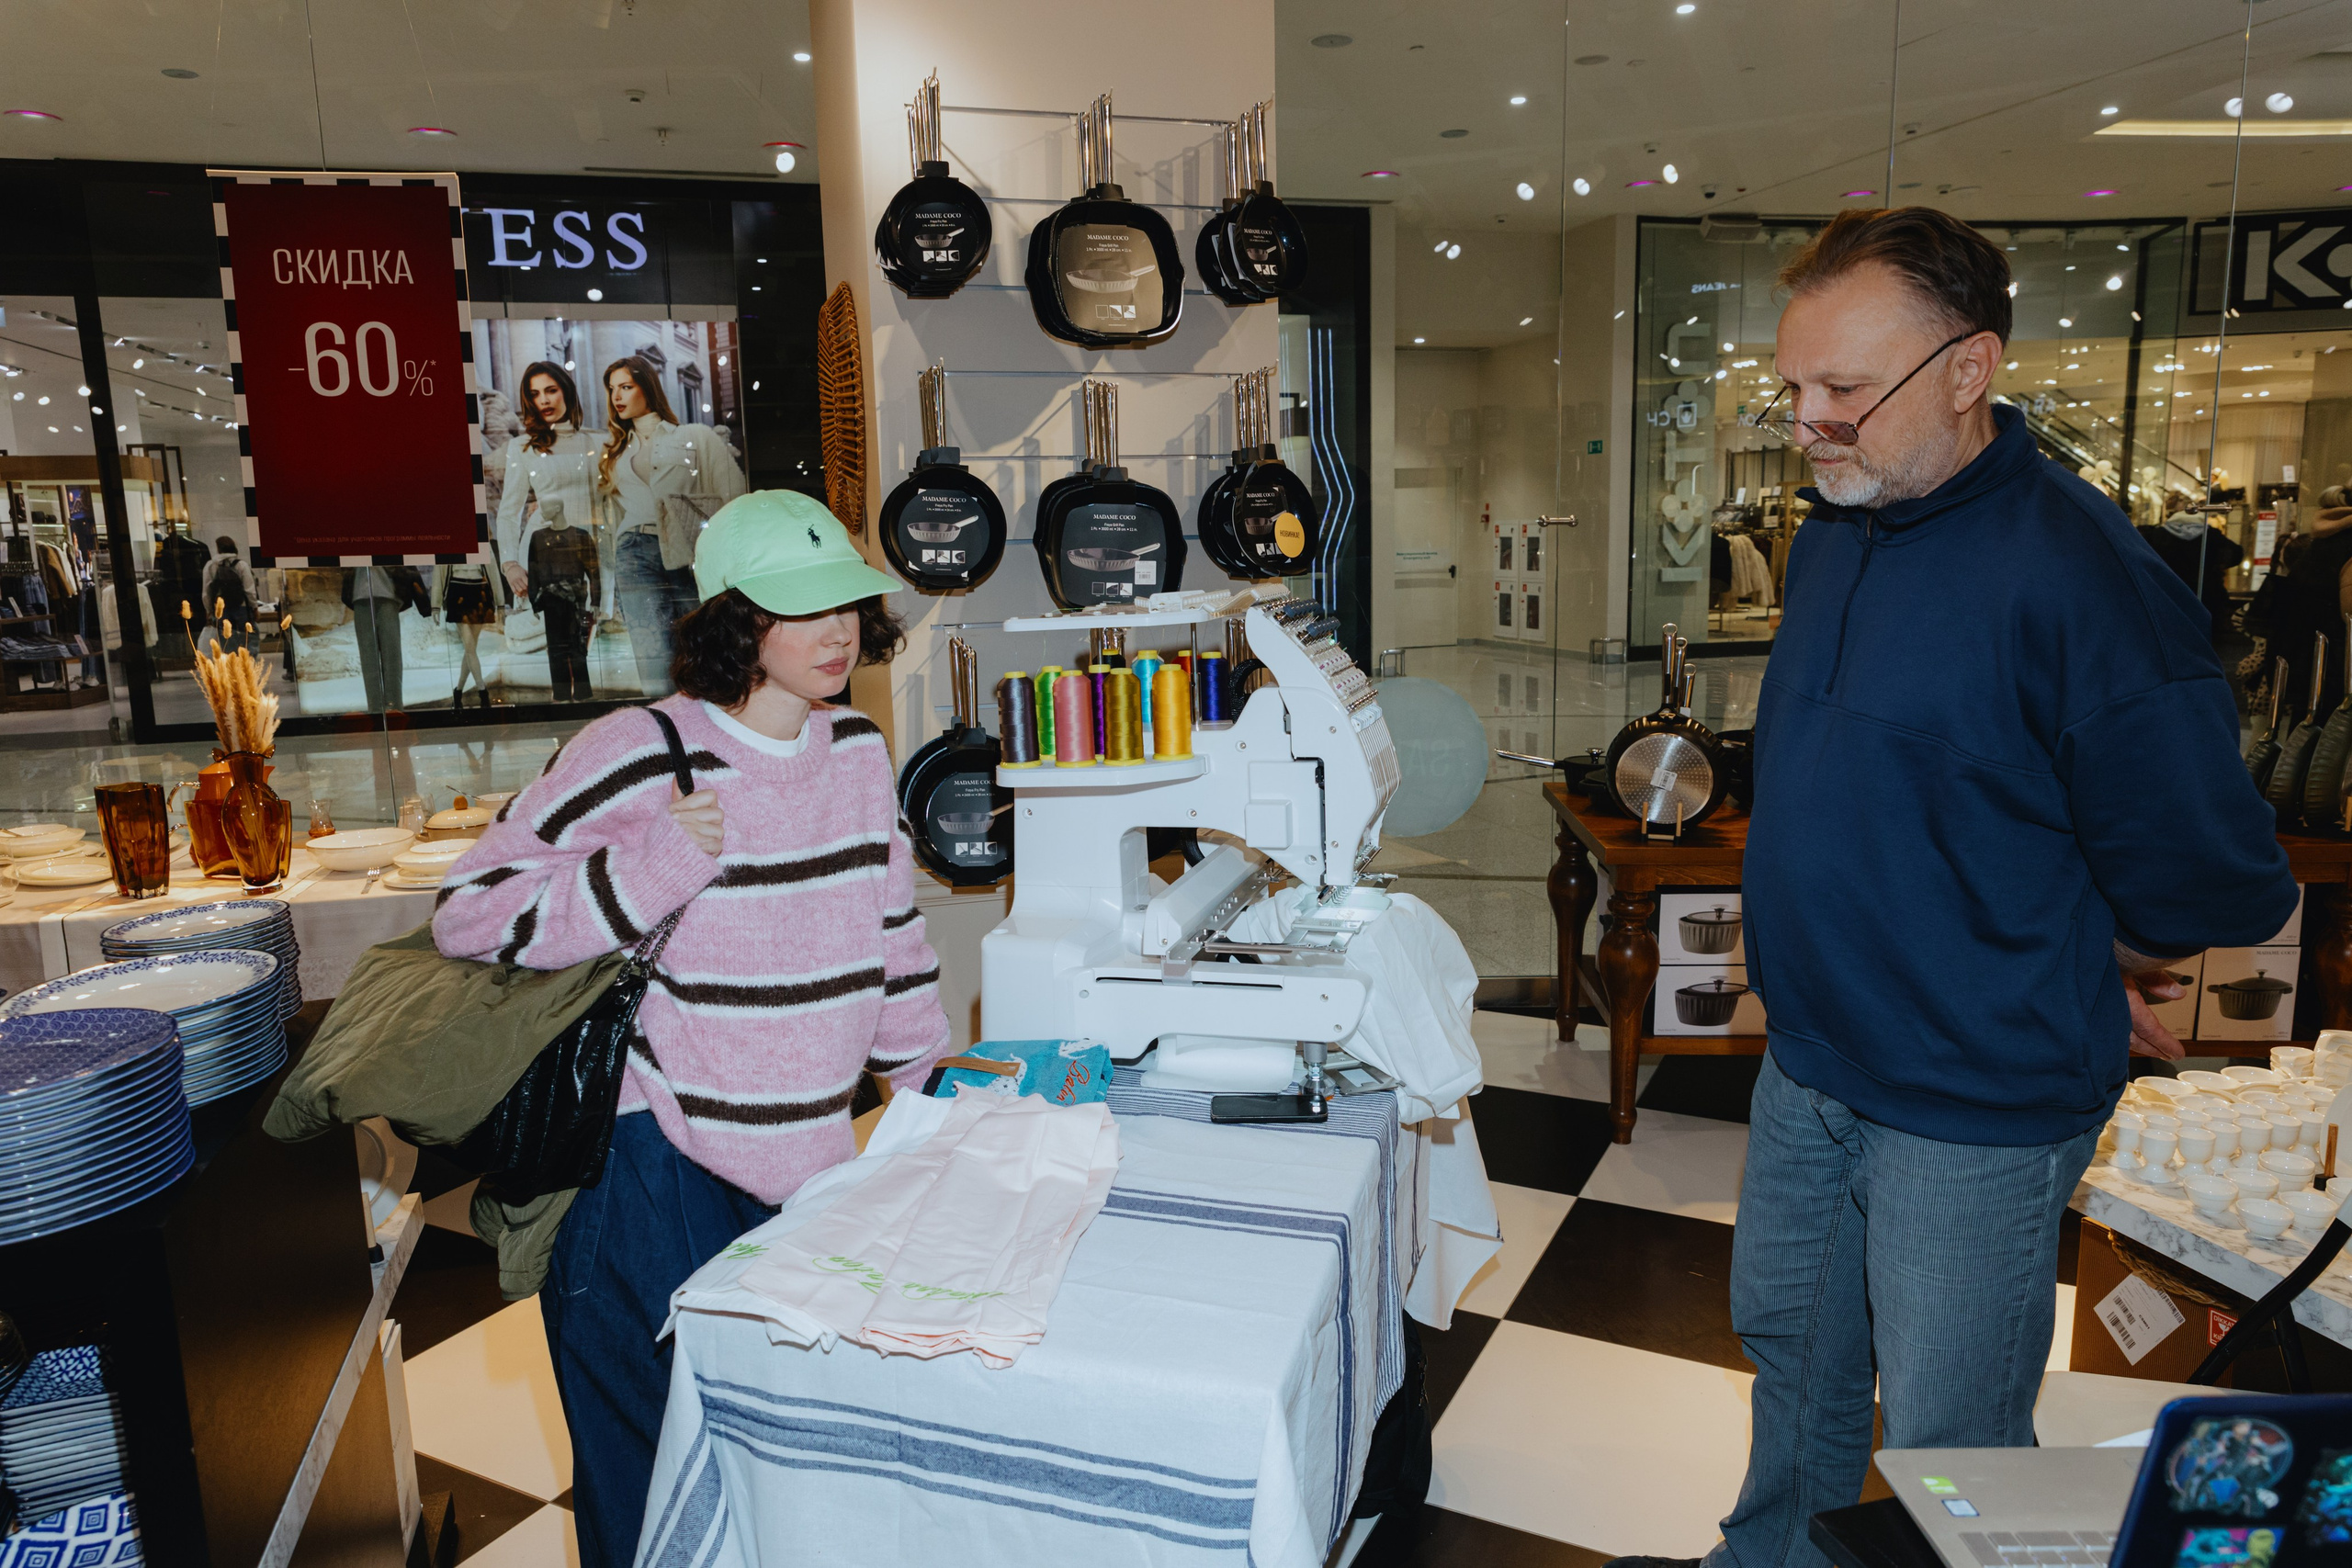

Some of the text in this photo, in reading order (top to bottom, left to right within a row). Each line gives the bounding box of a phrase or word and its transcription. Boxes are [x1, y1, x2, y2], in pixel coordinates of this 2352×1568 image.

[462, 208, 649, 270] ESS
[273, 248, 413, 289] СКИДКА
[1280, 530, 1300, 538] НОВИНКА!
